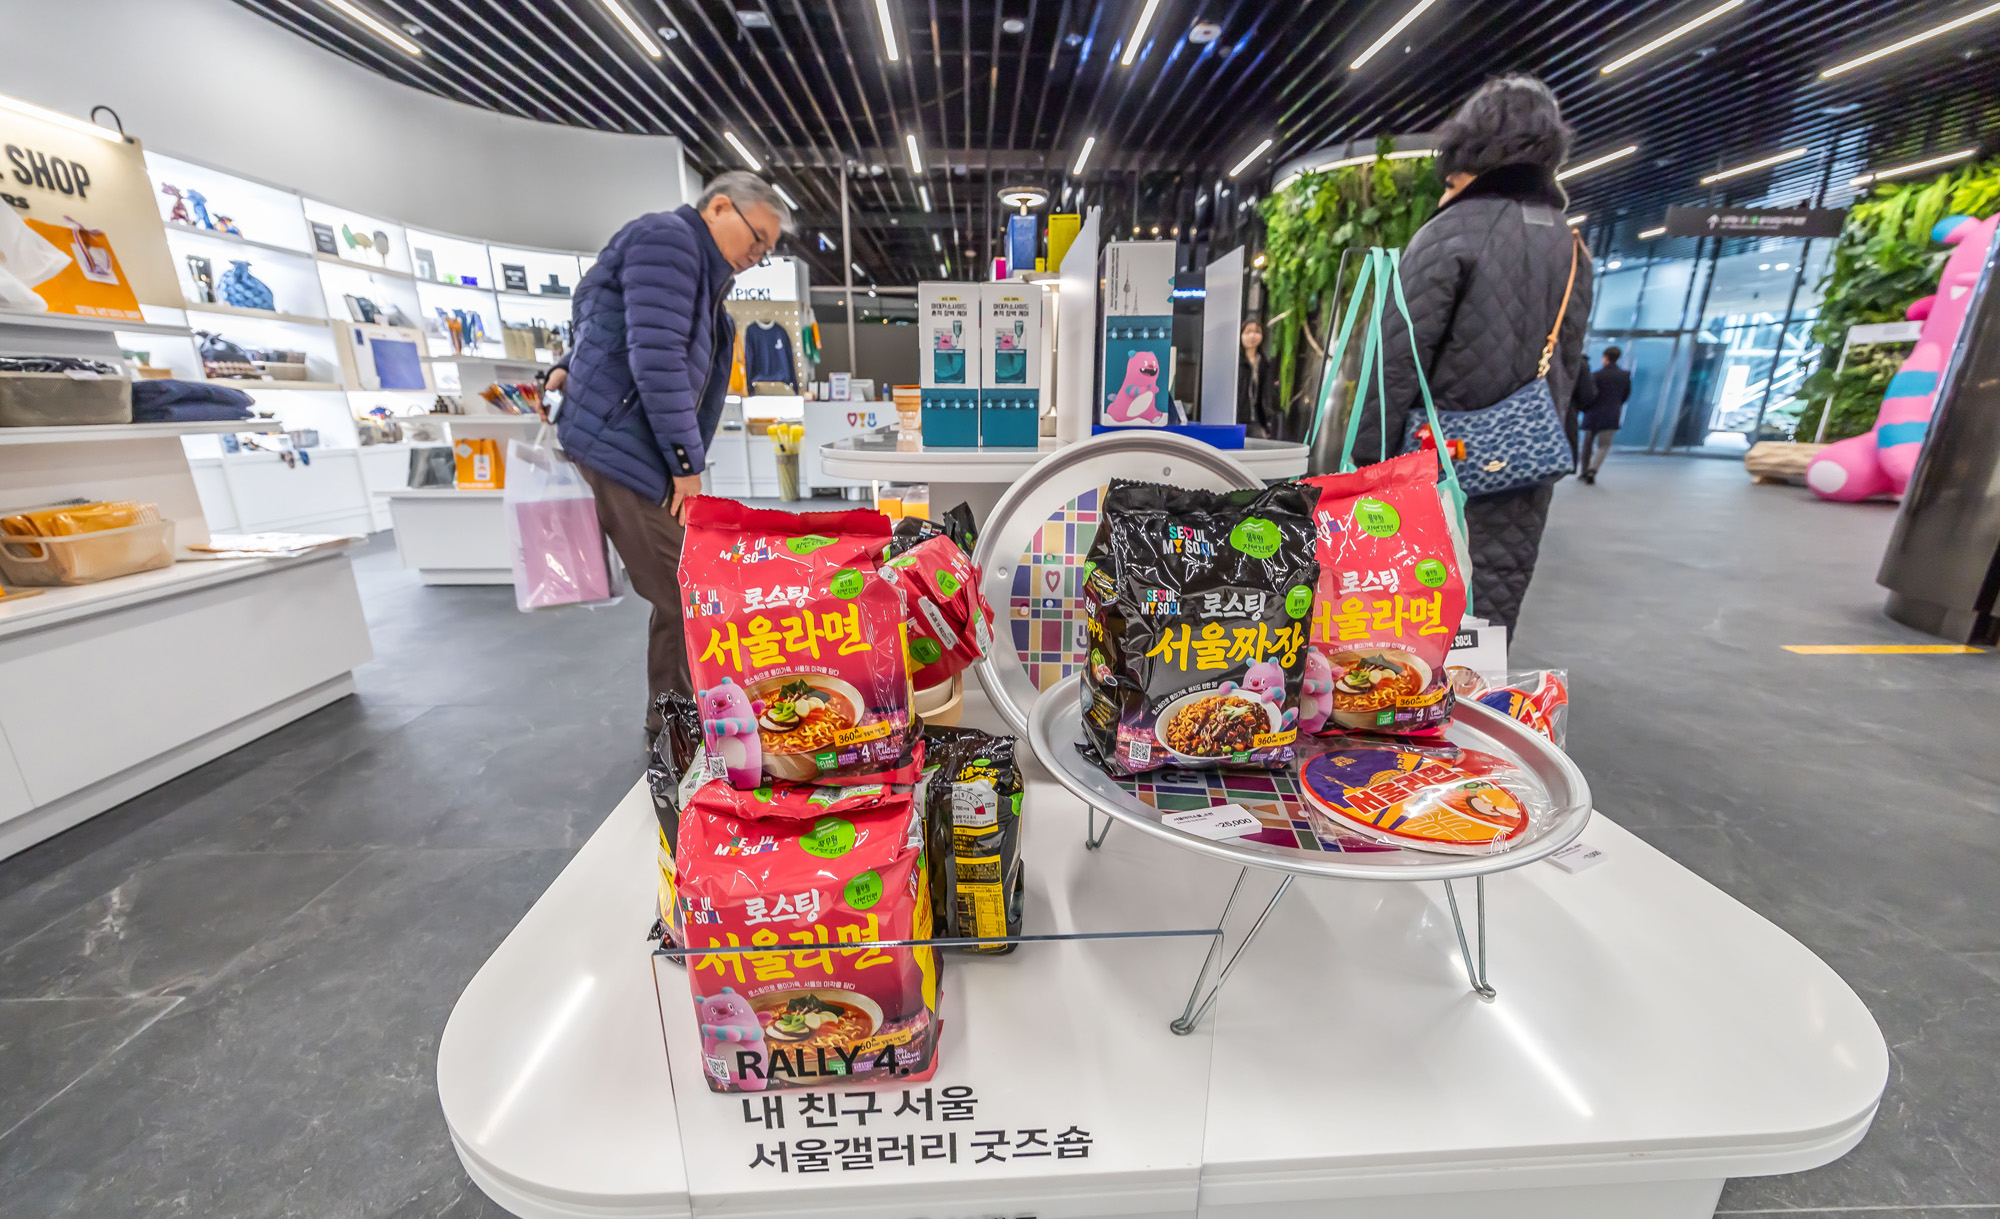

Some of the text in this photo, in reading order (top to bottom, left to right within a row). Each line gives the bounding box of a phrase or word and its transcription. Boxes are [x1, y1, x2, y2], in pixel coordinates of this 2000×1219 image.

[6, 144, 90, 199] SHOP
[1169, 526, 1208, 543] SEOUL
[1185, 541, 1218, 556] SOUL
[1339, 568, 1400, 594] 로스팅
[743, 584, 809, 614] 로스팅
[1146, 590, 1176, 602] SEOUL
[701, 602, 725, 617] SOUL
[1157, 602, 1182, 615] SOUL
[1200, 591, 1266, 621] 로스팅
[699, 603, 872, 672] 서울라면
[1145, 621, 1304, 671] 서울짜장
[1400, 698, 1415, 706] 360
[839, 732, 855, 744] 360
[1257, 736, 1272, 746] 360
[862, 744, 870, 758] 4
[741, 842, 779, 856] SOUL
[744, 889, 820, 926] 로스팅
[695, 911, 723, 924] SOUL
[736, 1043, 910, 1080] RALLY 4.
[742, 1085, 978, 1130] 내 친구 서울
[748, 1125, 1093, 1173] 서울갤러리 굿즈숍
